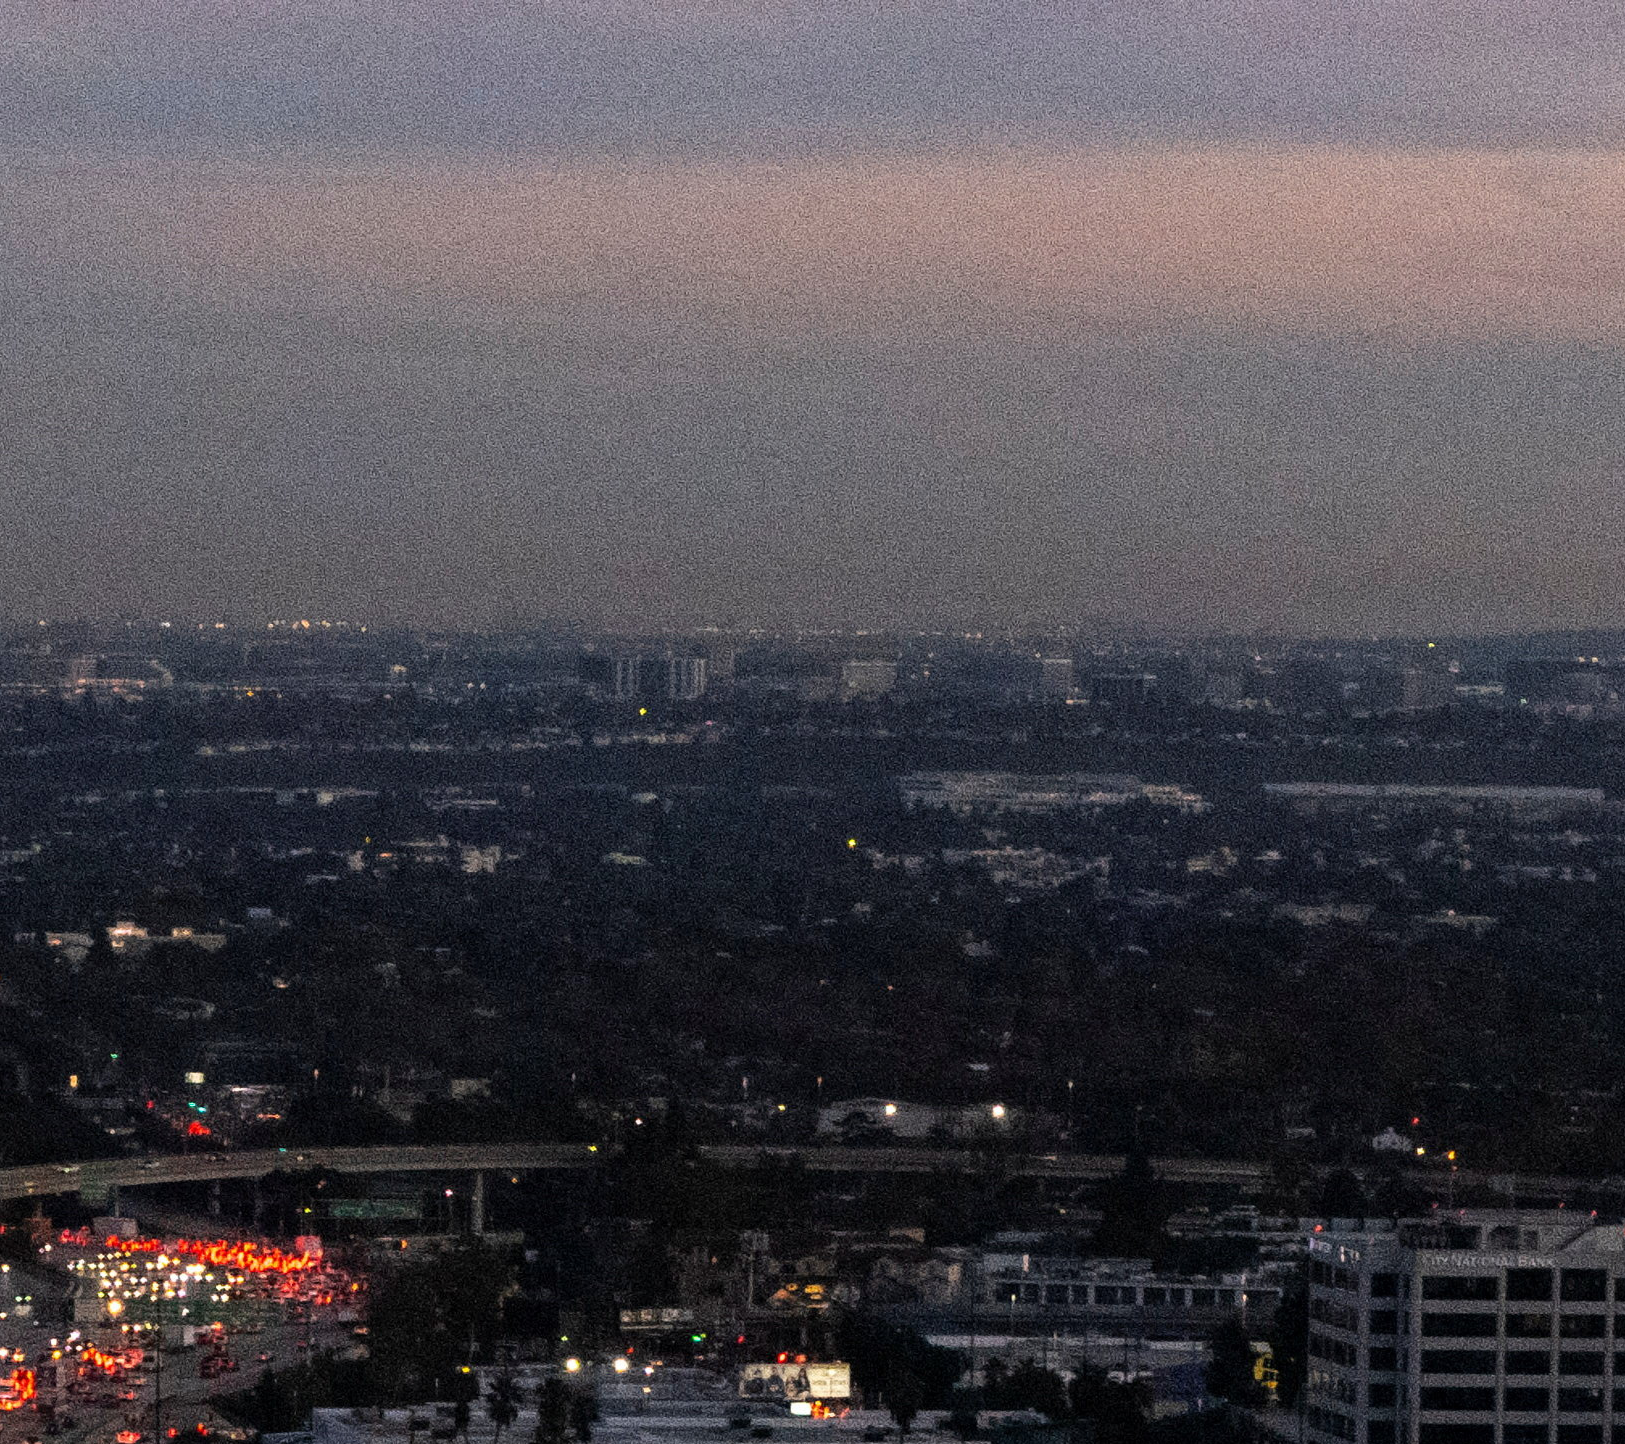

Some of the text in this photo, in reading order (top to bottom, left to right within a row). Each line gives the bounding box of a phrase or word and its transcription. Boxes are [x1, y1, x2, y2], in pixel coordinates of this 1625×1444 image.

[1423, 1254, 1556, 1268] CITY NATIONAL BANK
